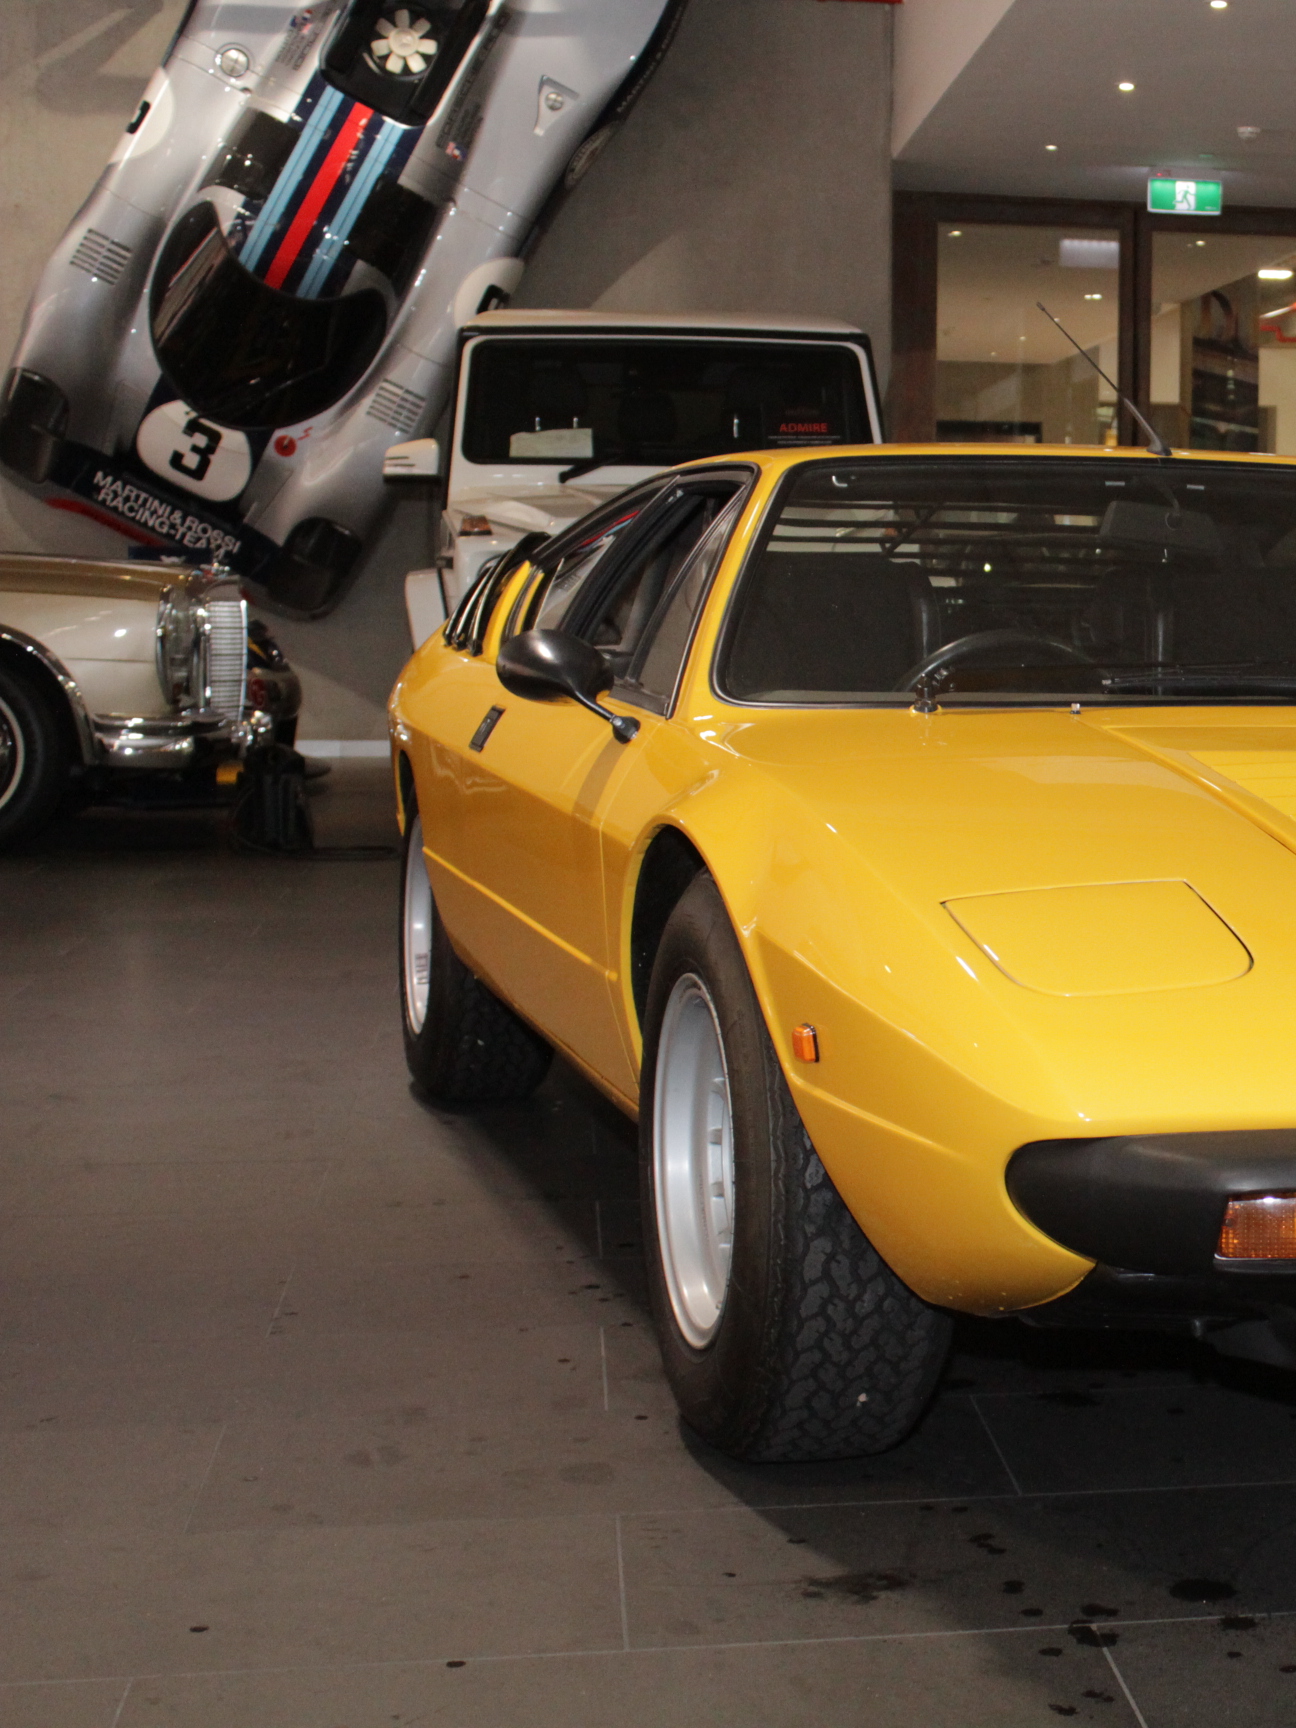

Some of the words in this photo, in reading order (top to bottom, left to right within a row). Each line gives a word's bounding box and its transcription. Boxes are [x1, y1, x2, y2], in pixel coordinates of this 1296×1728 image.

[169, 417, 222, 481] 3
[779, 422, 828, 433] ADMIRE
[93, 470, 171, 516] MARTINI
